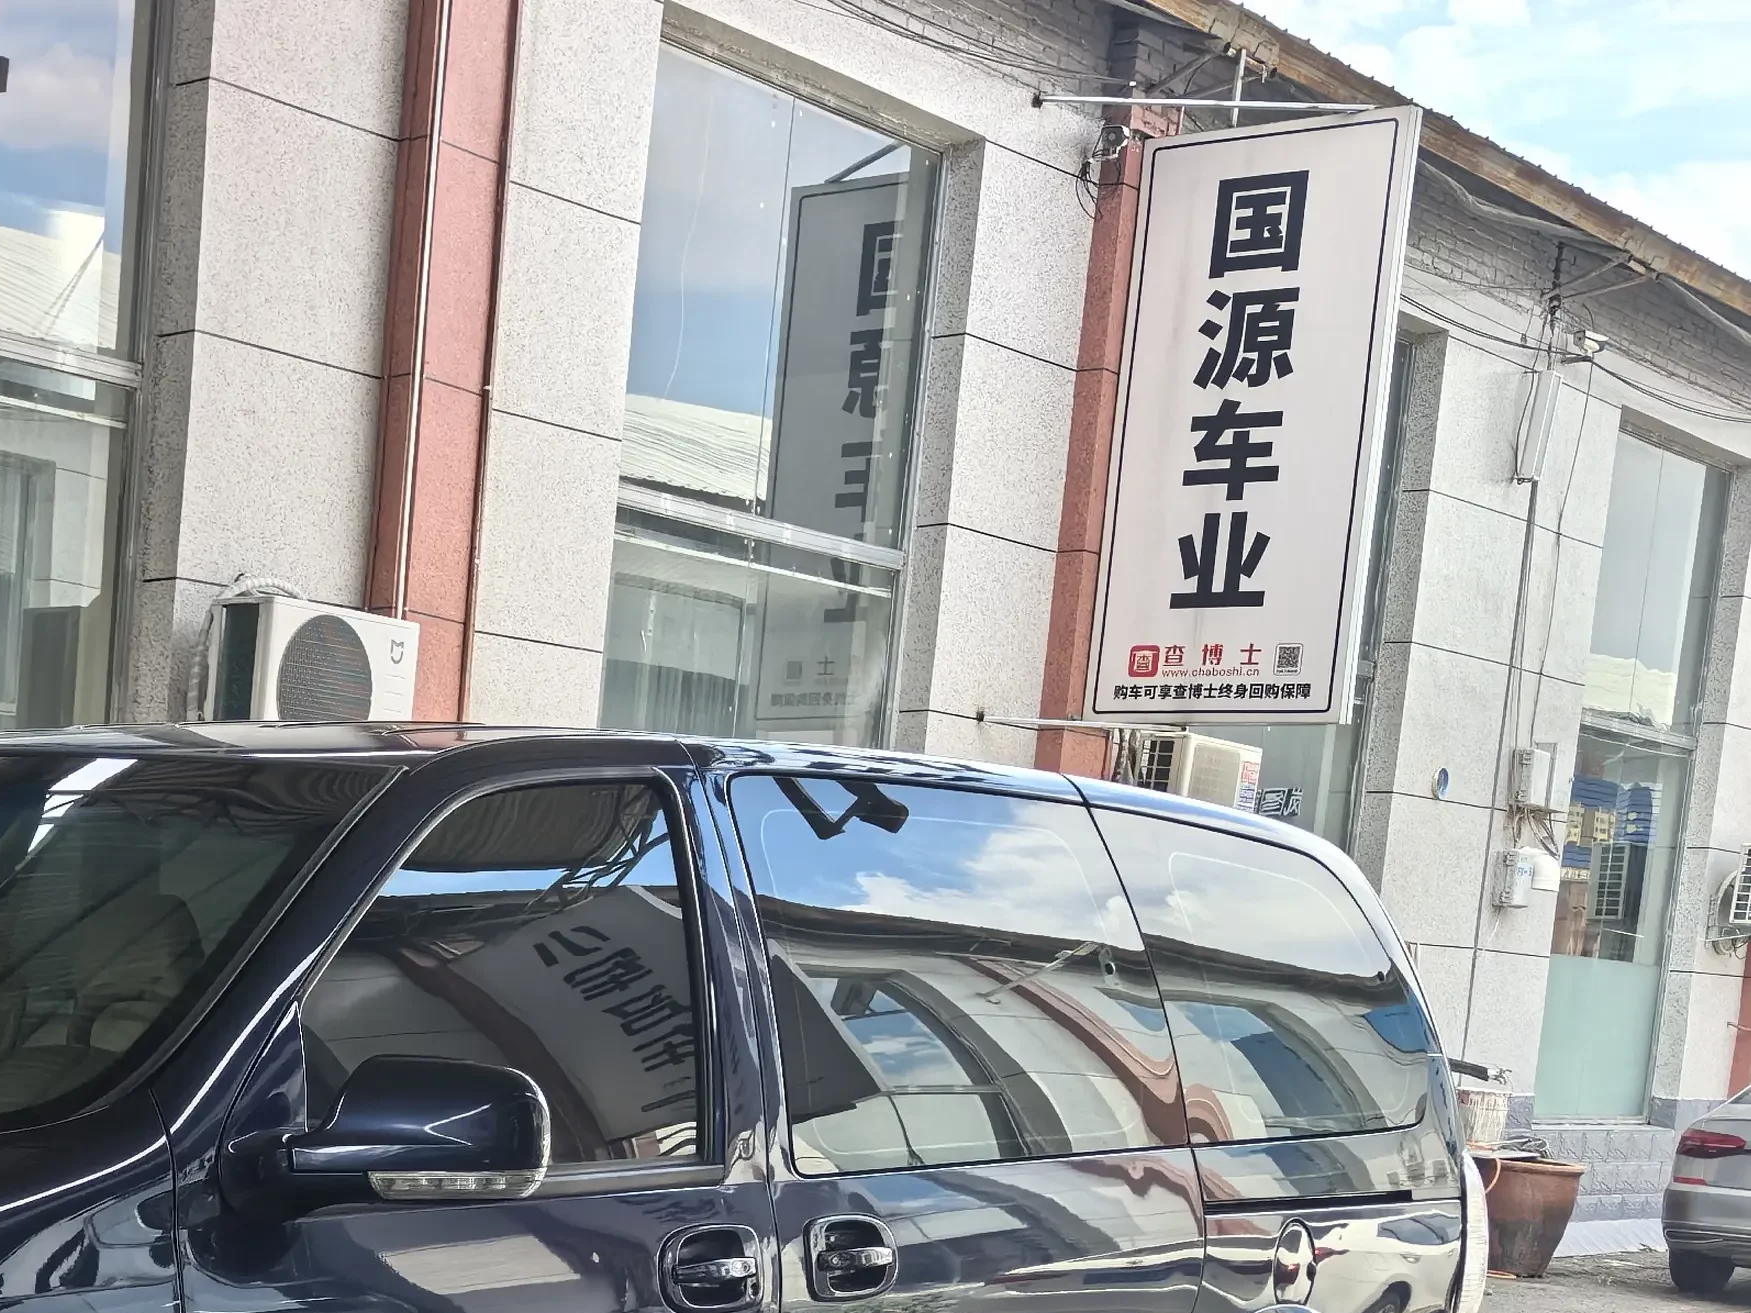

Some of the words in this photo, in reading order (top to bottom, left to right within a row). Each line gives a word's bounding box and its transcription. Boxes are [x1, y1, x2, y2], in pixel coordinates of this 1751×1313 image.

[1169, 170, 1310, 609] 国源车业
[1162, 642, 1263, 667] 查博士
[1161, 666, 1260, 678] www.chaboshi.cn
[1113, 683, 1312, 700] 购车可享查博士终身回购保障
